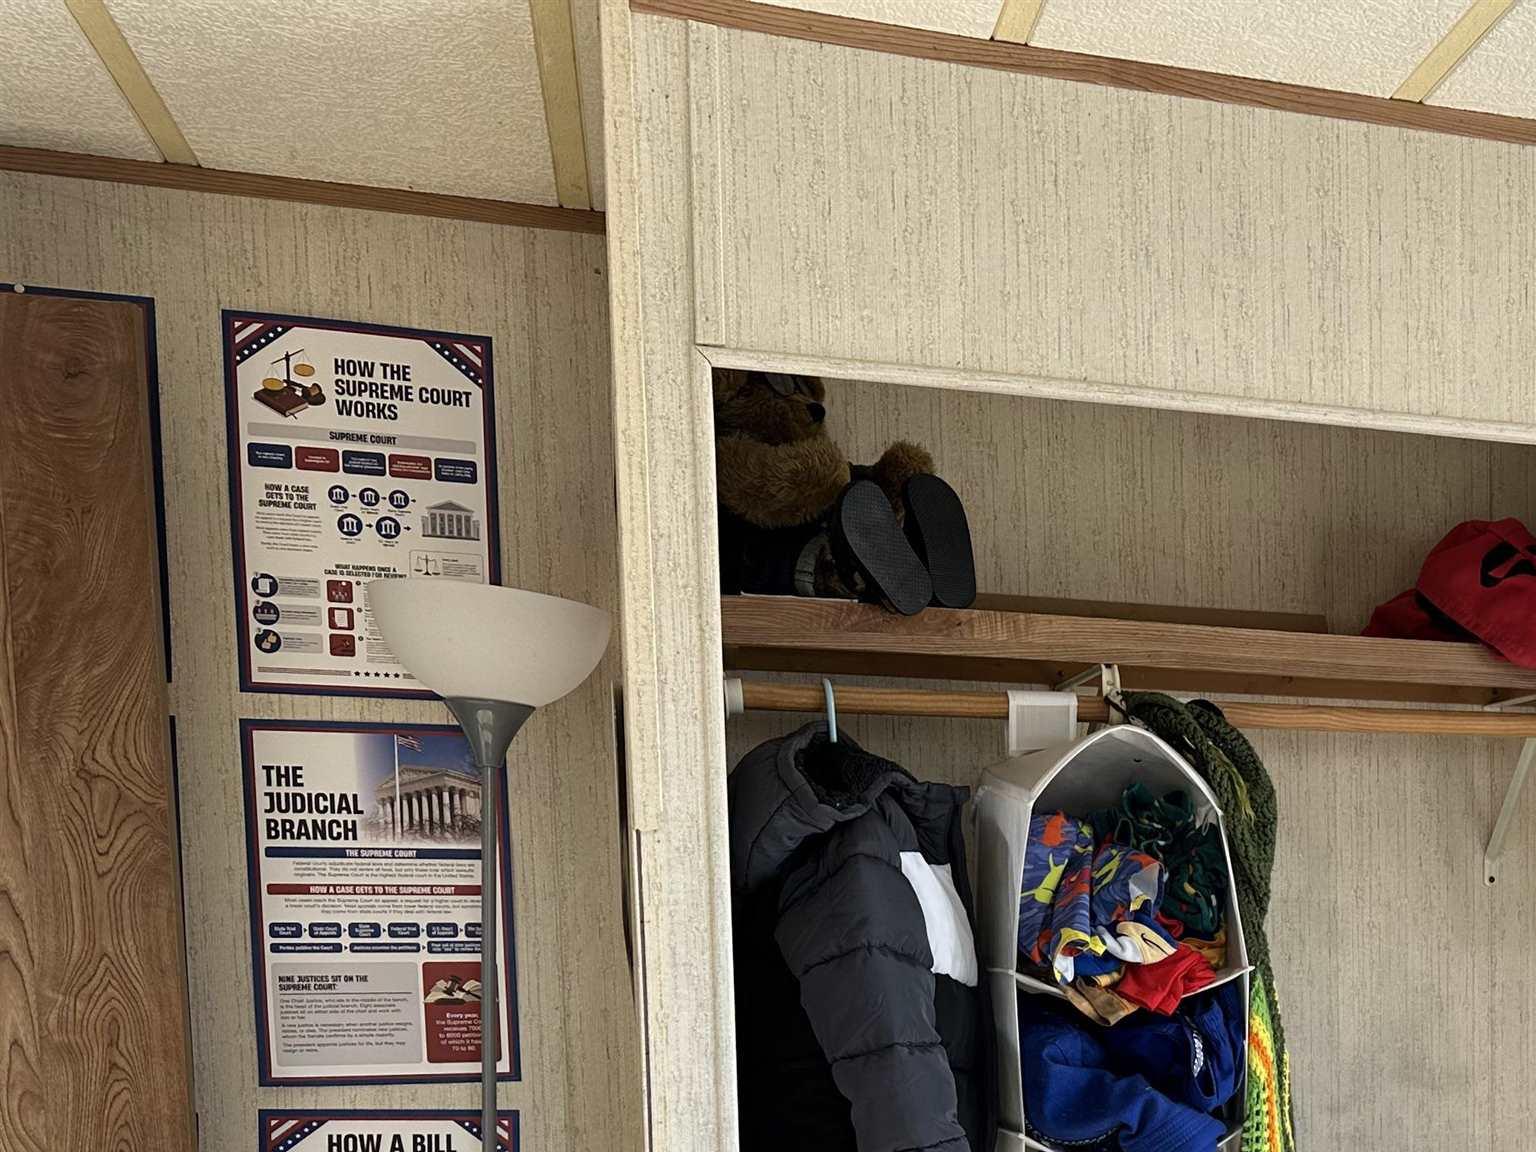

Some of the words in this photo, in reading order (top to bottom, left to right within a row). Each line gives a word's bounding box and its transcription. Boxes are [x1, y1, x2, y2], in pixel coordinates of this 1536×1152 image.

[334, 358, 380, 378] HOW
[381, 363, 411, 382] THE
[334, 378, 414, 402] SUPREME
[418, 387, 472, 408] COURT
[335, 399, 399, 421] WORKS
[329, 431, 368, 444] SUPREME
[369, 434, 397, 445] COURT
[264, 483, 282, 492] HOW
[284, 484, 290, 492] A
[291, 485, 310, 494] CASE
[265, 491, 284, 500] GETS
[285, 493, 294, 501] TO
[296, 493, 309, 502] THE
[258, 499, 292, 509] SUPREME
[293, 502, 317, 511] COURT
[261, 765, 304, 787] THE
[264, 793, 364, 815] JUDICIAL
[266, 819, 358, 841] BRANCH
[345, 849, 359, 857] THE
[360, 849, 393, 857] SUPREME
[394, 850, 417, 858] COURT
[309, 886, 327, 894] HOW
[328, 886, 335, 894] A
[336, 886, 354, 894] CASE
[355, 886, 373, 894] GETS
[374, 886, 384, 894] TO
[385, 886, 398, 894] THE
[399, 886, 432, 895] SUPREME
[432, 886, 455, 895] COURT
[278, 975, 295, 983] NINE
[297, 975, 330, 983] JUSTICES
[331, 975, 342, 983] SIT
[344, 975, 354, 983] ON
[278, 983, 312, 991] SUPREME
[313, 983, 337, 991] COURT
